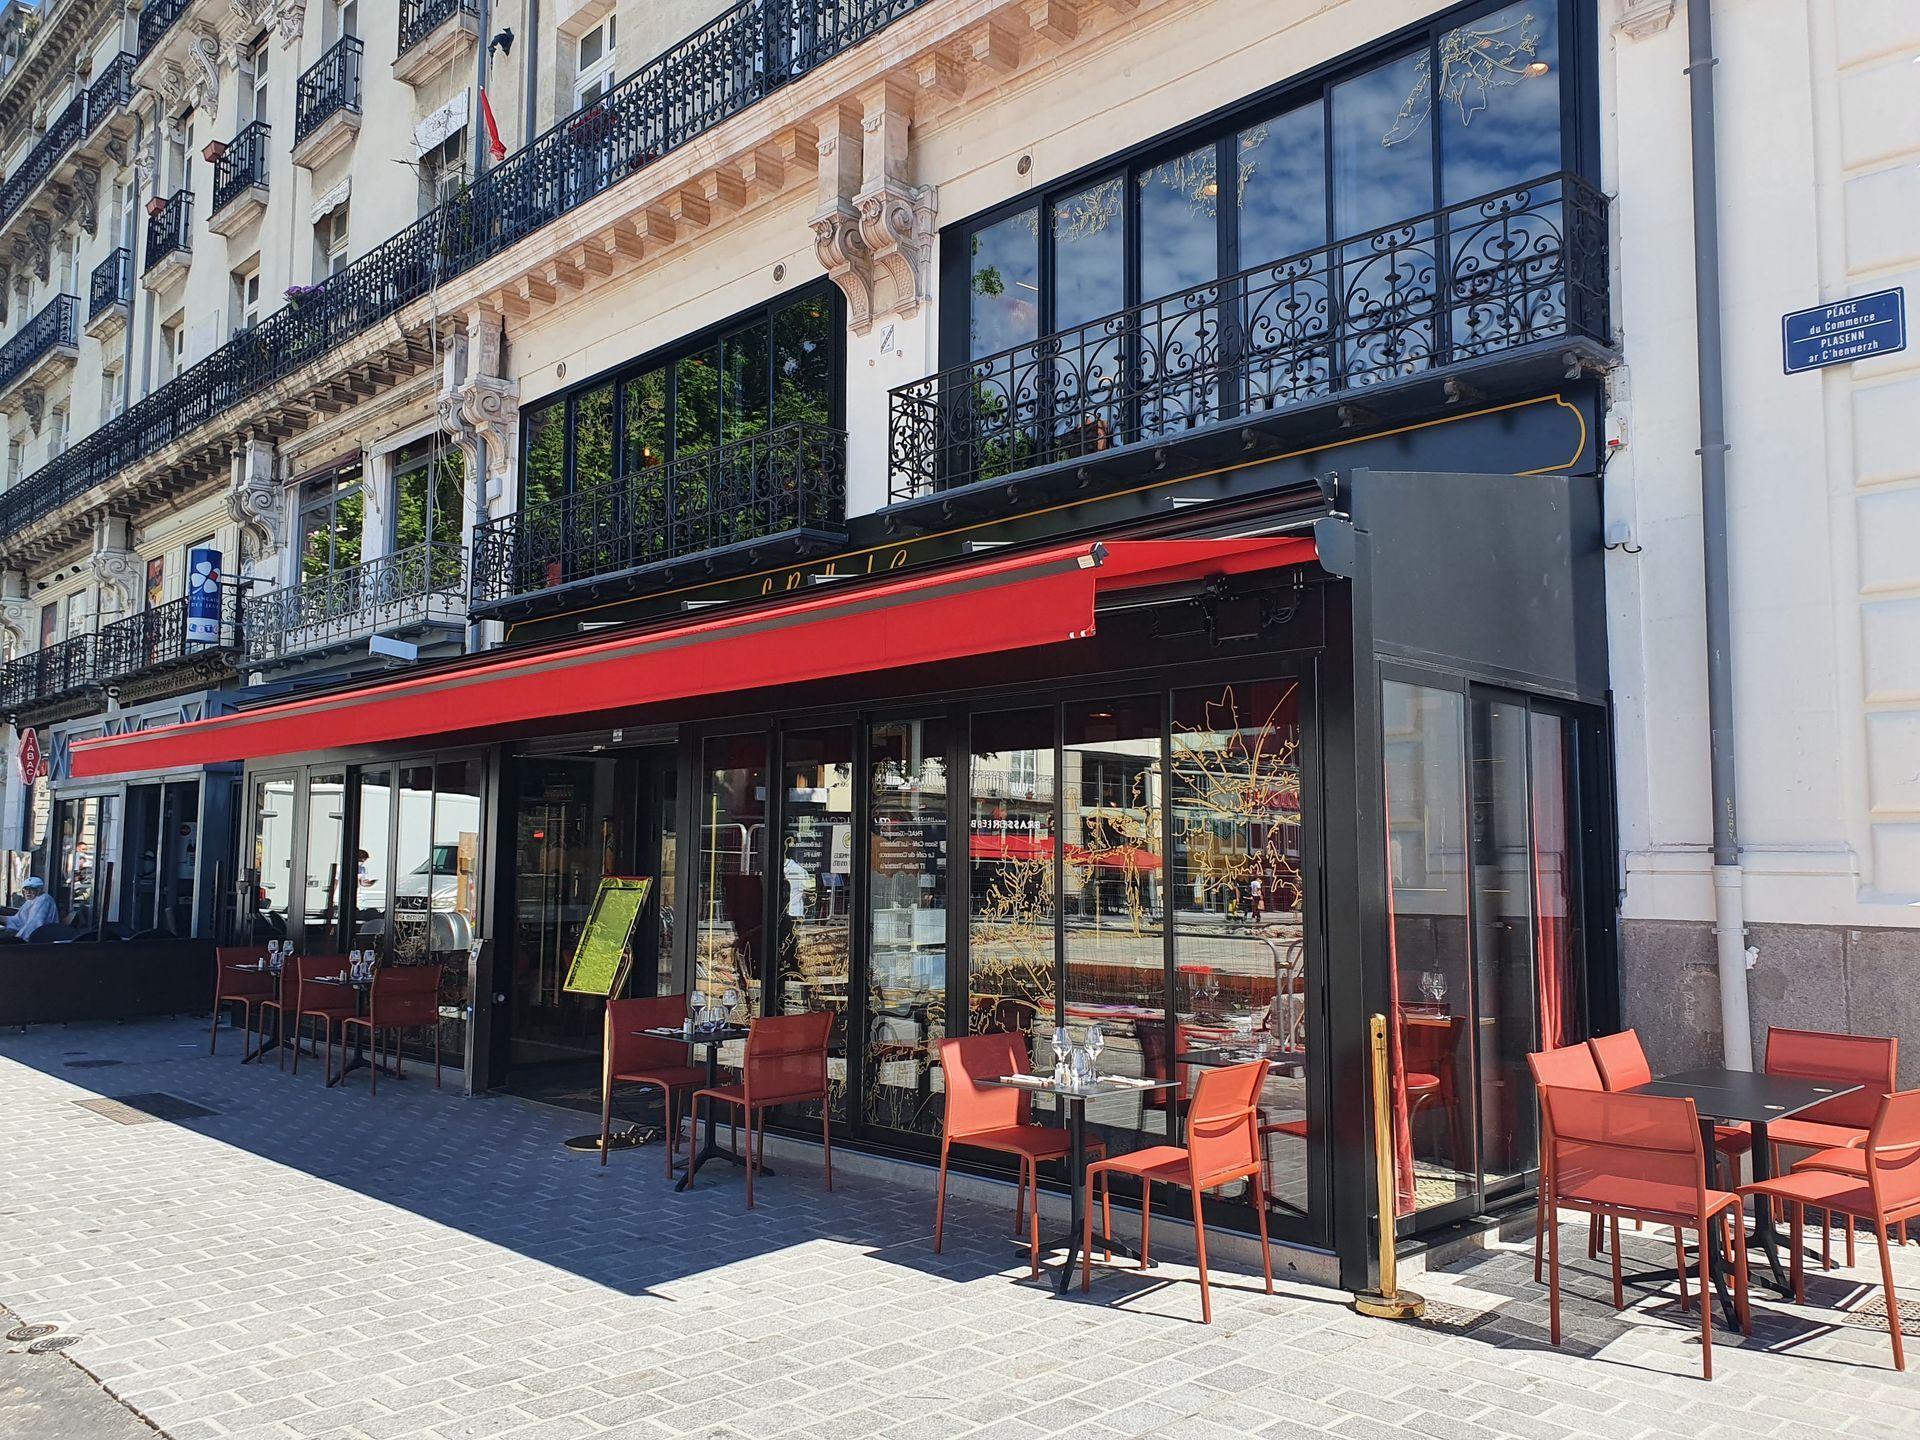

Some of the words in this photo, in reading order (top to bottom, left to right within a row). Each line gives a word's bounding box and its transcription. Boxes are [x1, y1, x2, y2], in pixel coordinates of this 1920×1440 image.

[1826, 303, 1858, 319] PLACE
[1809, 325, 1821, 335] du
[1825, 312, 1876, 332] Commerce
[1820, 330, 1865, 348] PLASENN
[1808, 353, 1819, 363] ar
[1822, 339, 1879, 360] C'henwerzh
[26, 737, 35, 776] TABAC
